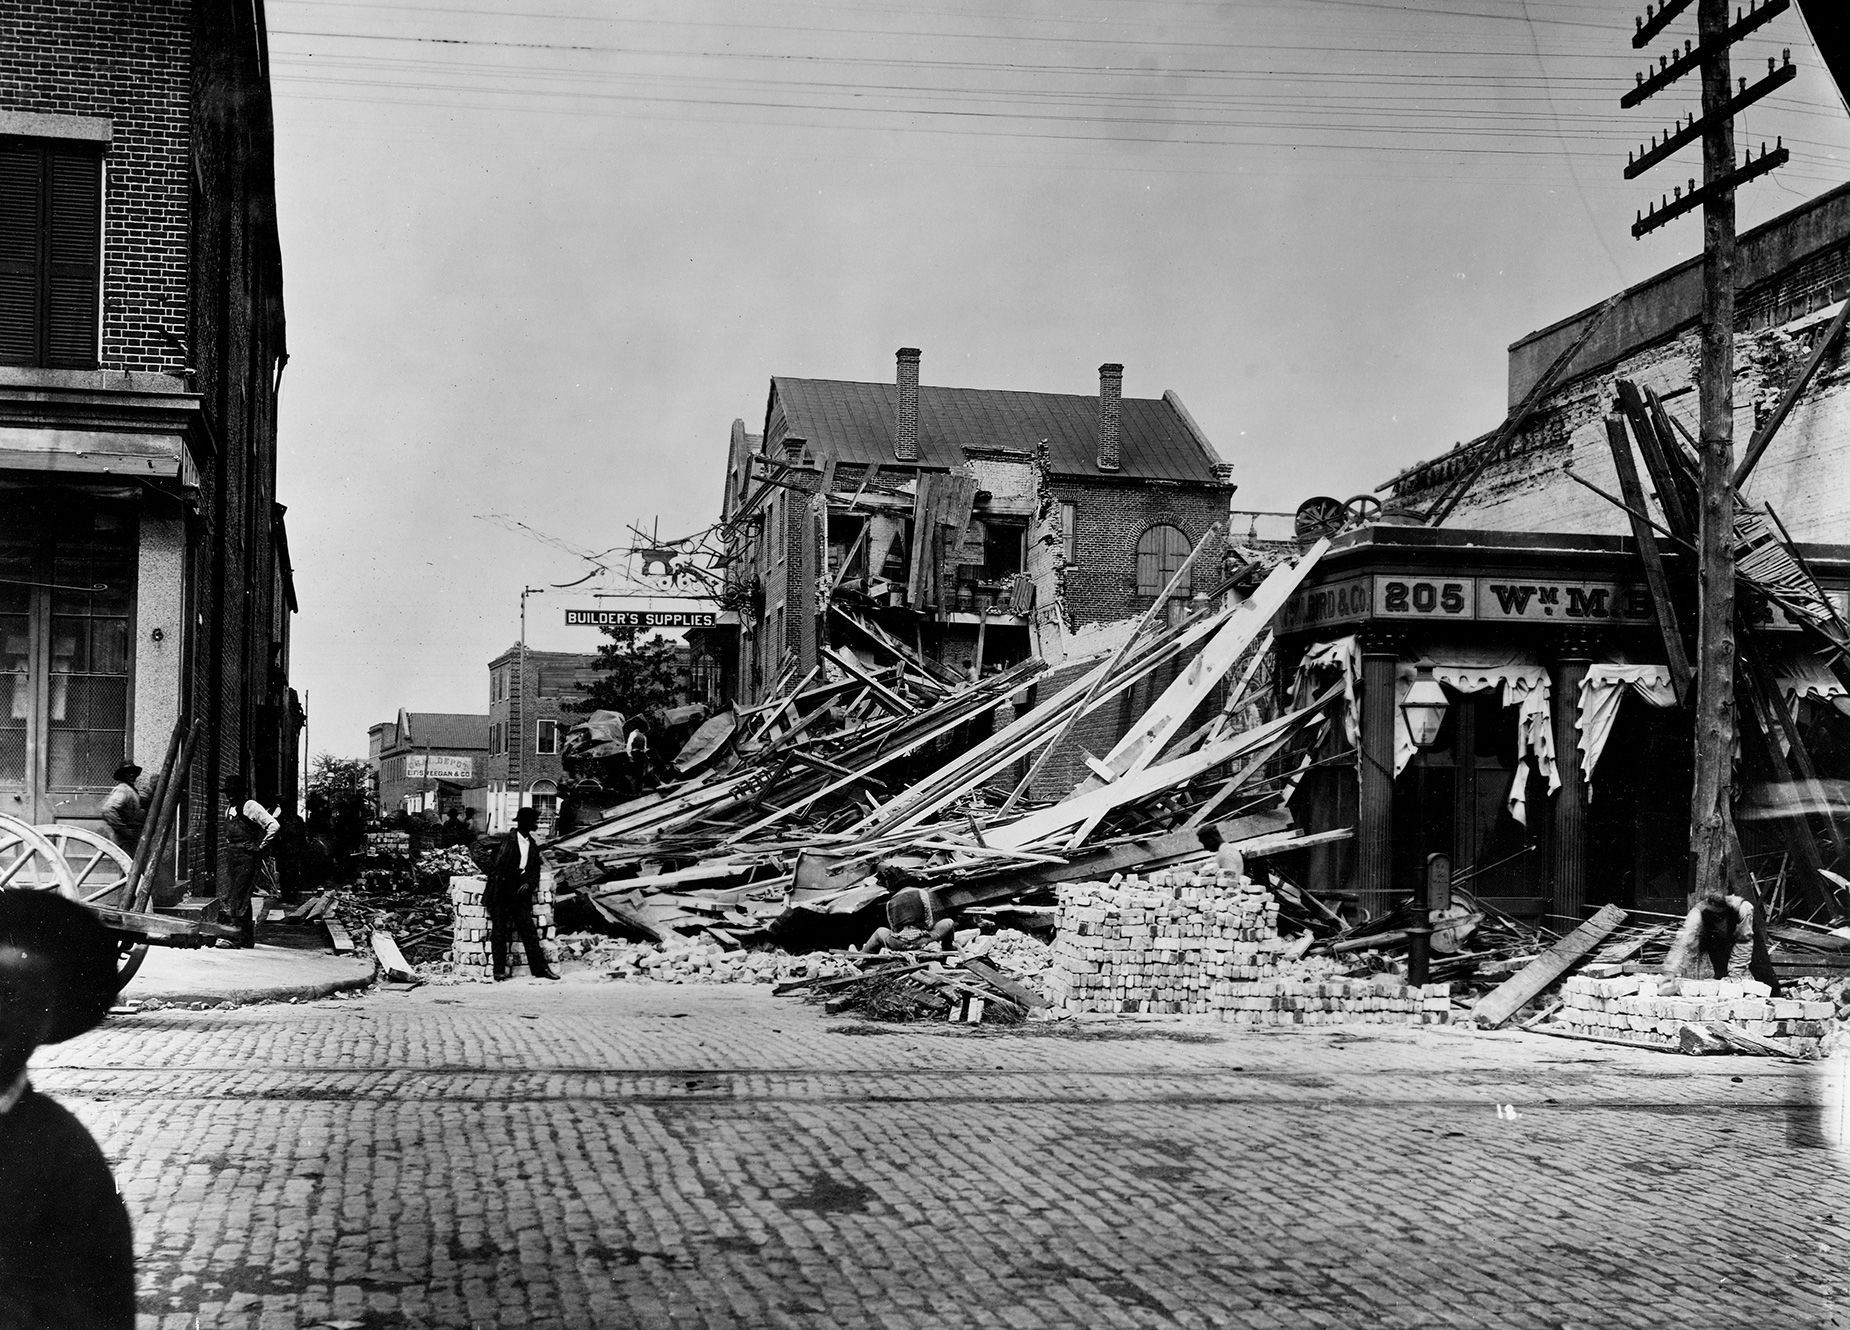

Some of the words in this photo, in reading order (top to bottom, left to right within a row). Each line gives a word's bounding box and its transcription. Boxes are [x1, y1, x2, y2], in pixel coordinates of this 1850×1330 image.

[1385, 582, 1465, 613] 205
[568, 612, 639, 625] BUILDER'S
[646, 613, 715, 626] SUPPLIES.
